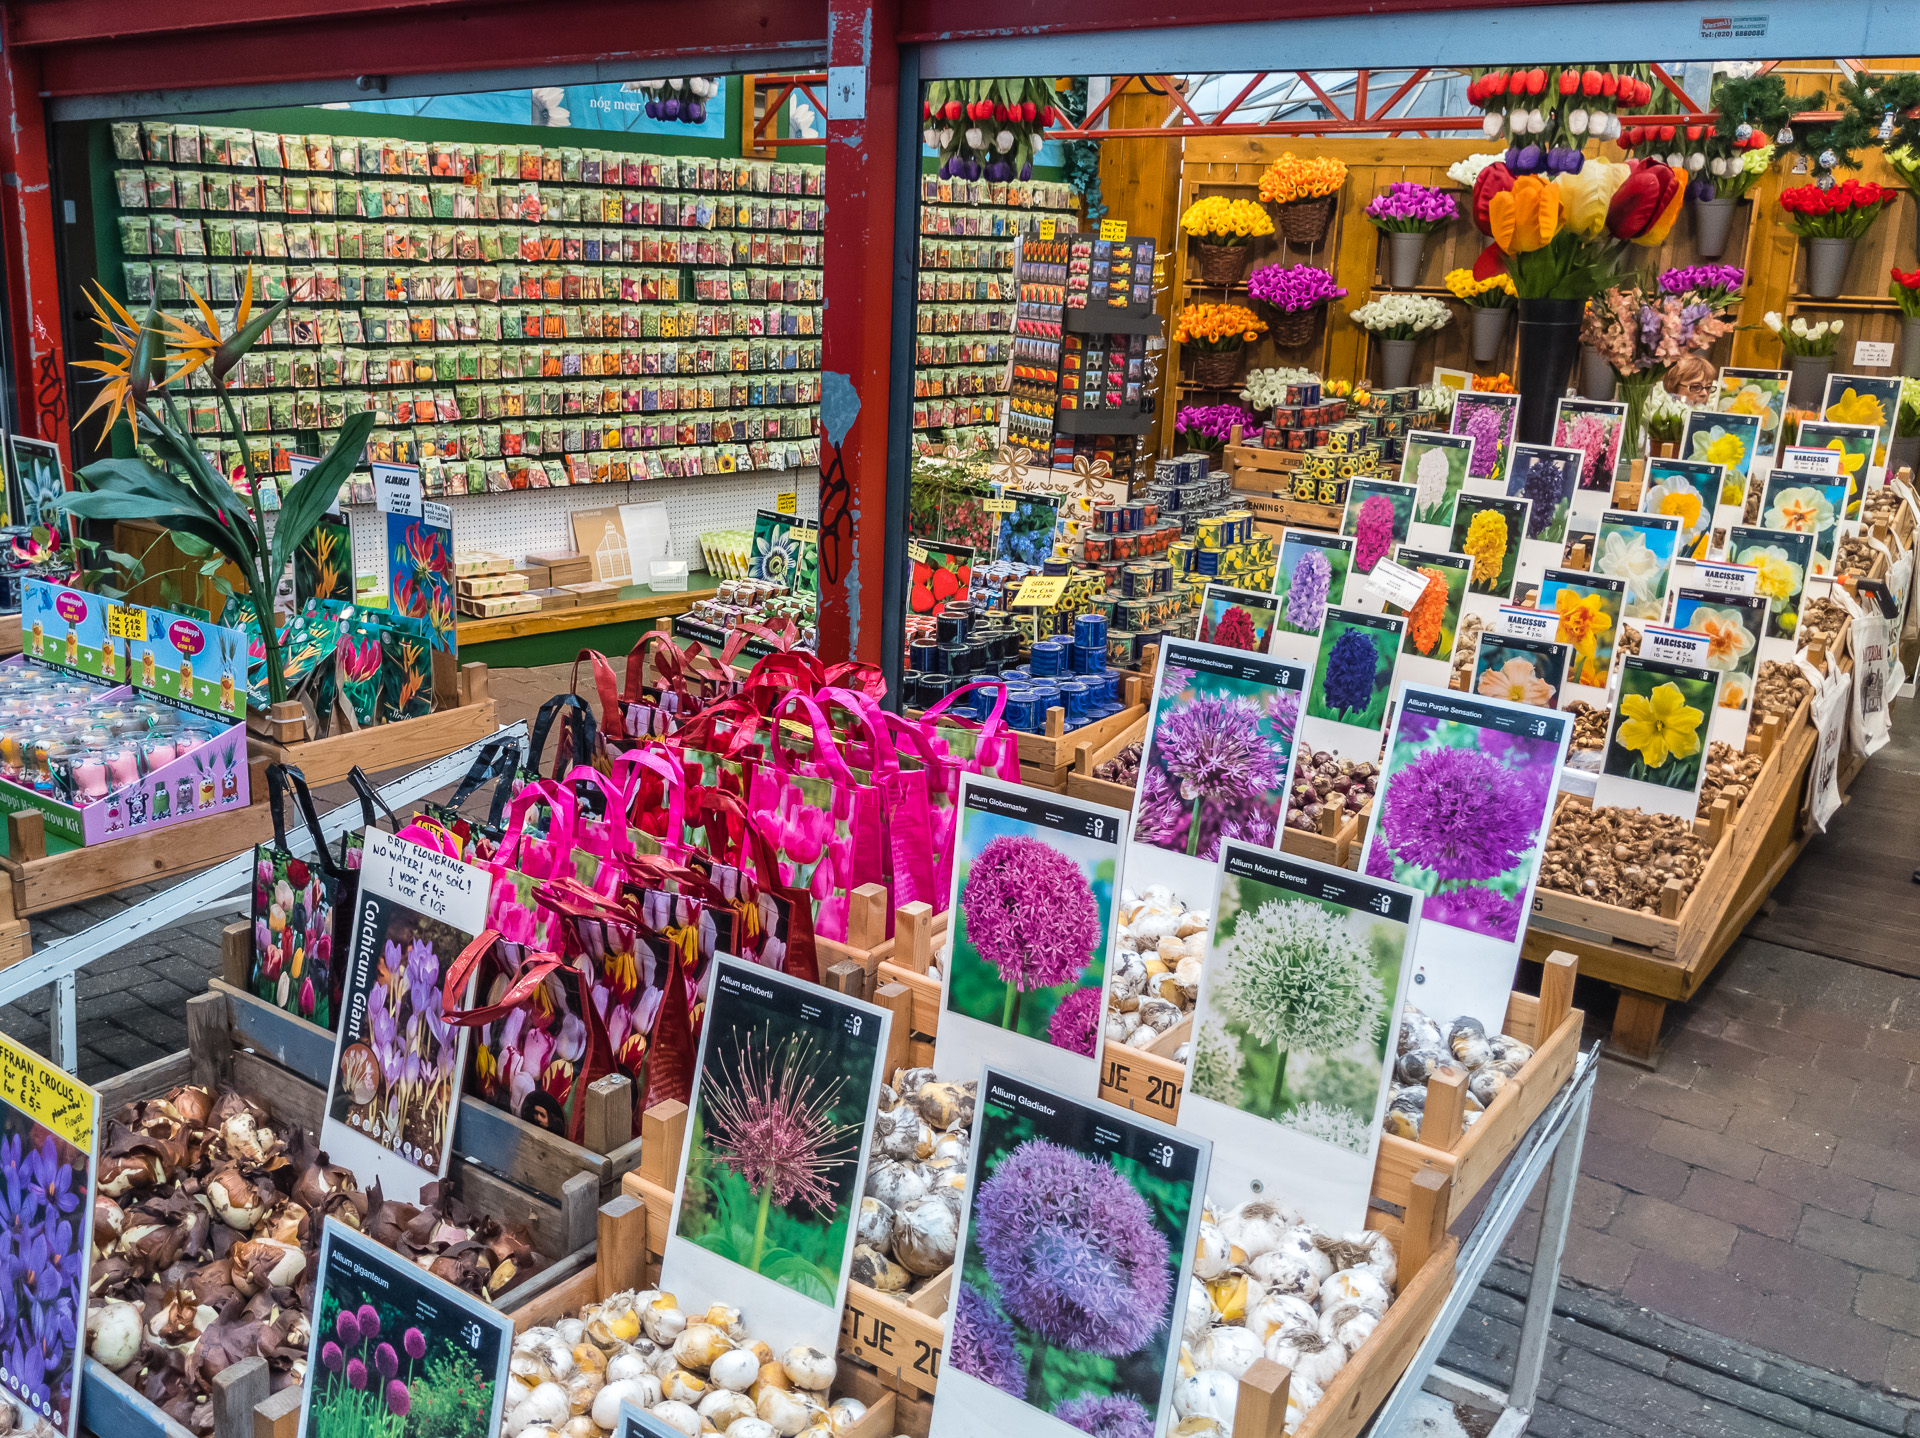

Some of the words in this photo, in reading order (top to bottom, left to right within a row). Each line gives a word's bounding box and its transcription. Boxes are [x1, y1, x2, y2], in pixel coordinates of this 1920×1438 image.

[590, 96, 611, 112] nóg
[614, 100, 641, 111] meer
[1794, 455, 1829, 463] NARCISSUS
[385, 475, 410, 487] GLORIOSA
[1705, 570, 1745, 581] NARCISSUS
[1508, 615, 1547, 628] NARCISSUS
[1654, 636, 1696, 650] NARCISSUS
[1170, 652, 1187, 661] Allium
[1408, 699, 1428, 708] Allium
[1428, 702, 1450, 713] Purple
[1450, 706, 1482, 719] Sensation
[969, 793, 988, 803] Allium
[988, 798, 1028, 813] Globemaster
[41, 808, 64, 827] Grow
[66, 817, 80, 834] Kit
[373, 844, 386, 856] NO
[389, 850, 424, 874] WATER!
[388, 836, 407, 854] DRY
[412, 845, 464, 874] FLOWERING
[390, 866, 394, 877] 1
[422, 880, 430, 893] €
[1230, 857, 1253, 870] Allium
[1254, 864, 1278, 878] Mount
[1279, 871, 1308, 886] Everest
[388, 878, 394, 888] 3
[420, 894, 427, 906] €
[356, 900, 380, 988] Colchicum
[720, 974, 741, 988] Allium
[741, 982, 774, 1000] schubertii
[348, 993, 368, 1040] Giant
[4, 1064, 16, 1080] for
[22, 1075, 28, 1088] €
[40, 1070, 74, 1102] CROCUS
[4, 1079, 15, 1094] for
[20, 1090, 26, 1104] €
[990, 1085, 1016, 1102] Allium
[1018, 1094, 1056, 1117] Gladiator
[52, 1105, 68, 1124] plant
[332, 1250, 353, 1268] Allium
[354, 1264, 390, 1290] giganteum
